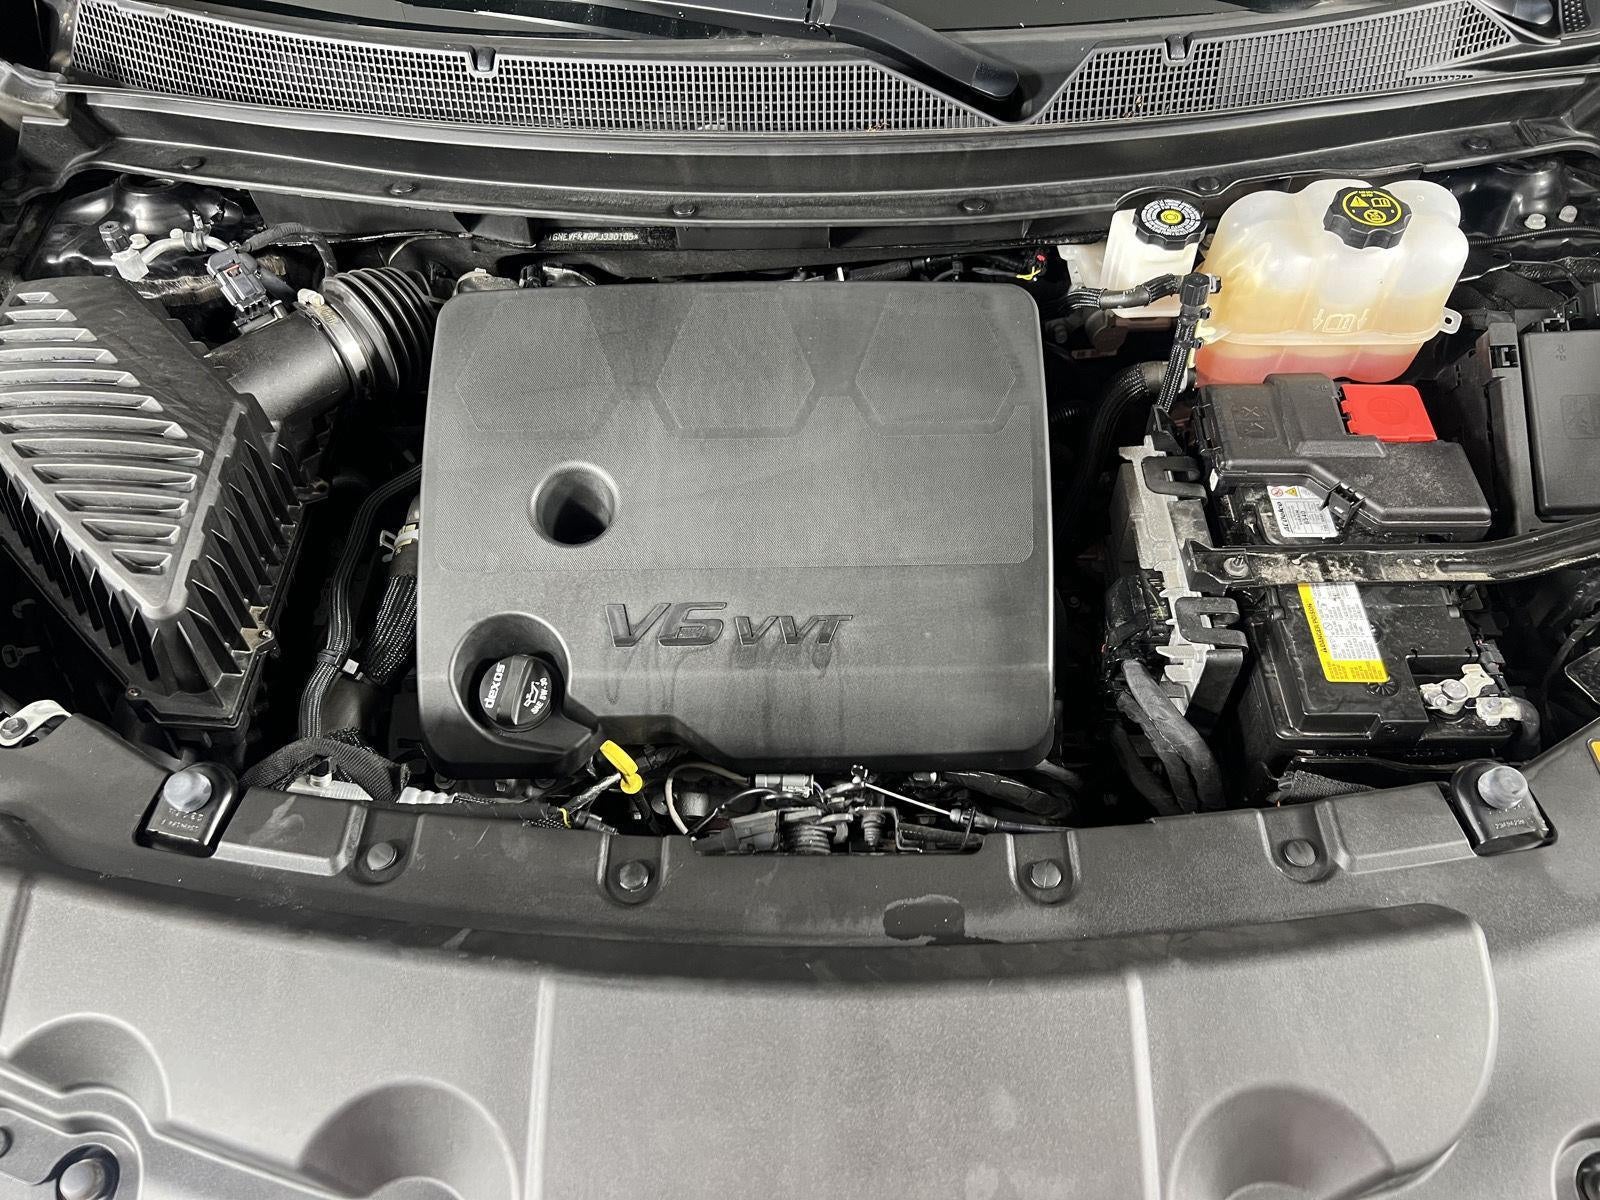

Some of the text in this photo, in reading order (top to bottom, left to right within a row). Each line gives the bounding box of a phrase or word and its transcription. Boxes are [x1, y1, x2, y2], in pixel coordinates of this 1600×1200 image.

[605, 601, 853, 648] V6 VVT
[484, 662, 506, 709] dexos
[530, 700, 545, 715] SAE
